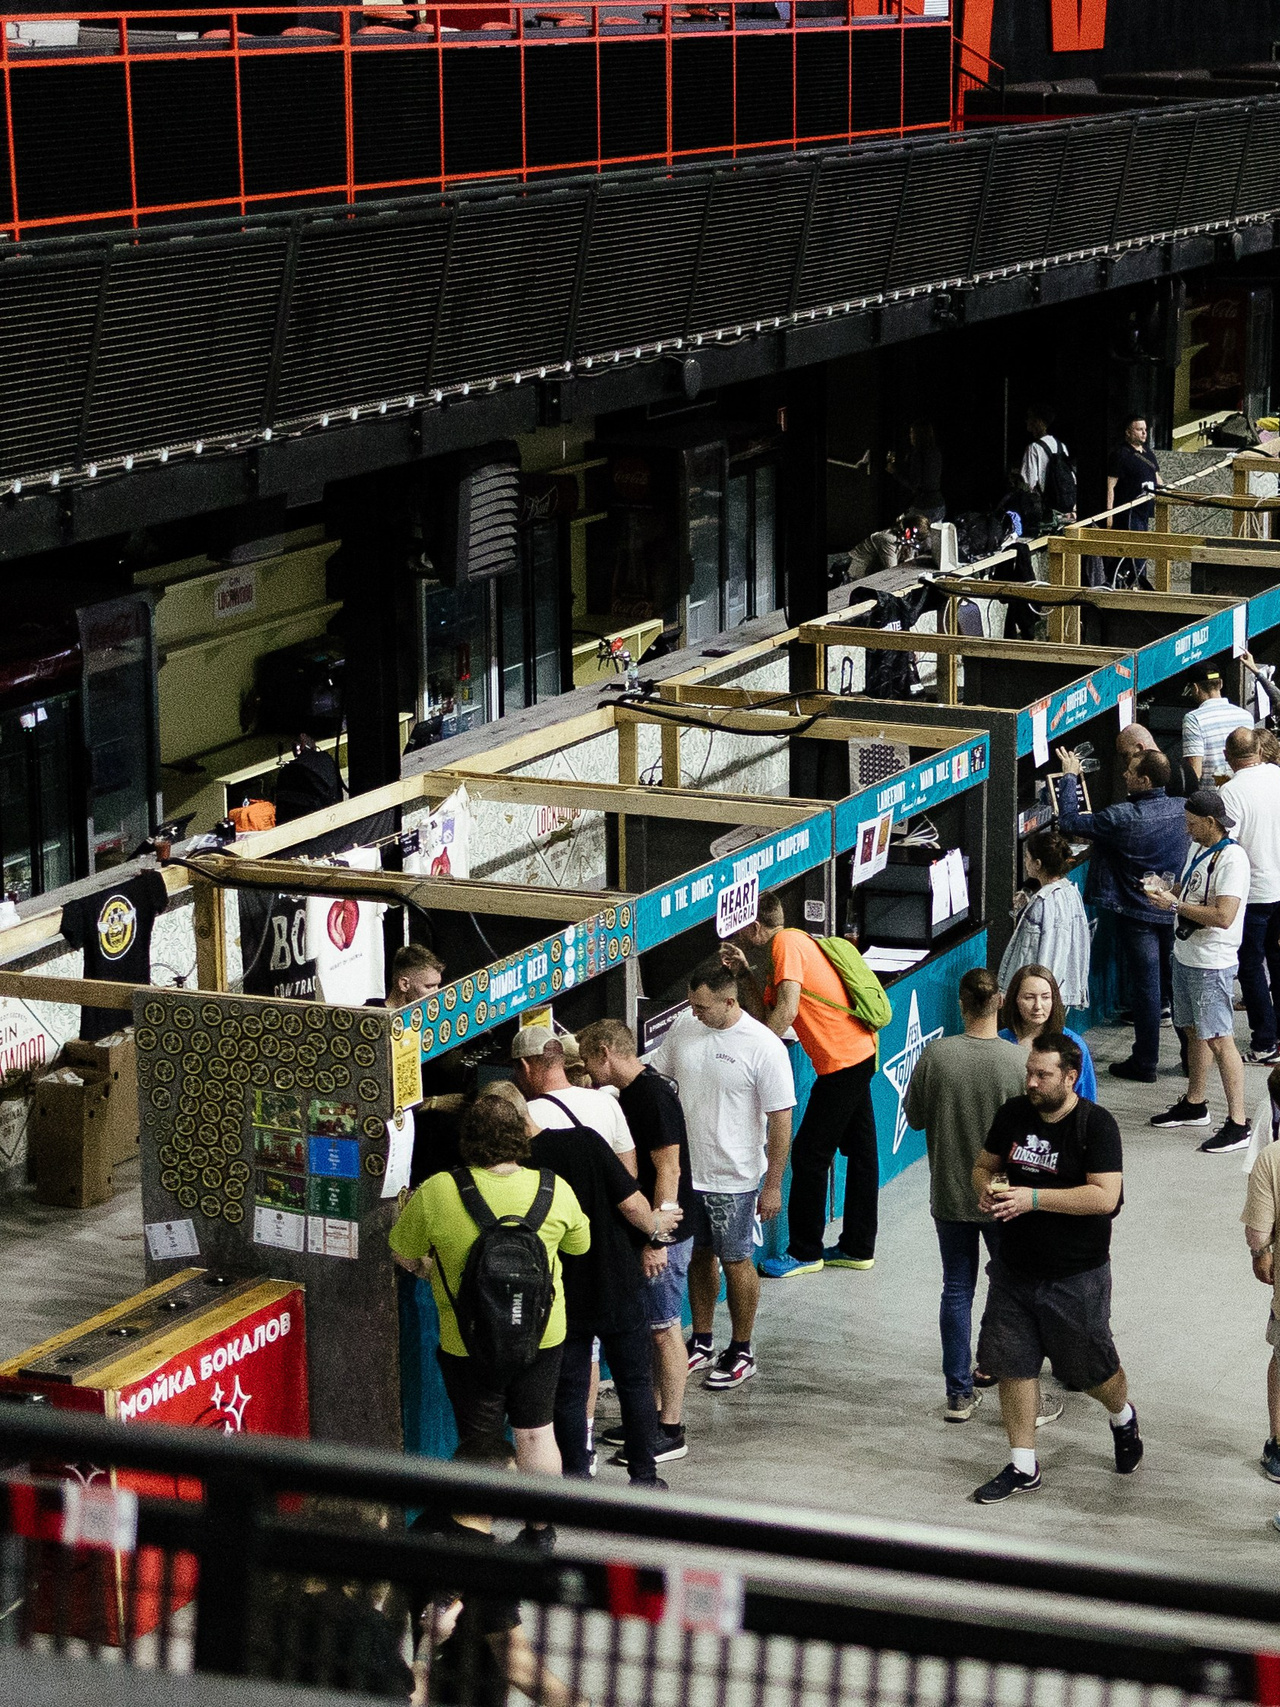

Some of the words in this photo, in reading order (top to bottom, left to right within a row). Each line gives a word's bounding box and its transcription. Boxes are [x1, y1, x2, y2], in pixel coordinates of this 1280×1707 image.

[674, 885, 689, 912] THE
[720, 878, 757, 919] HEART
[490, 963, 524, 1003] BUMBLE
[526, 953, 548, 984] BEER
[1008, 1141, 1060, 1174] LONSDALE
[511, 1292, 524, 1325] THULE
[119, 1365, 197, 1424] МОЙКА
[199, 1312, 292, 1382] БОКАЛОВ
